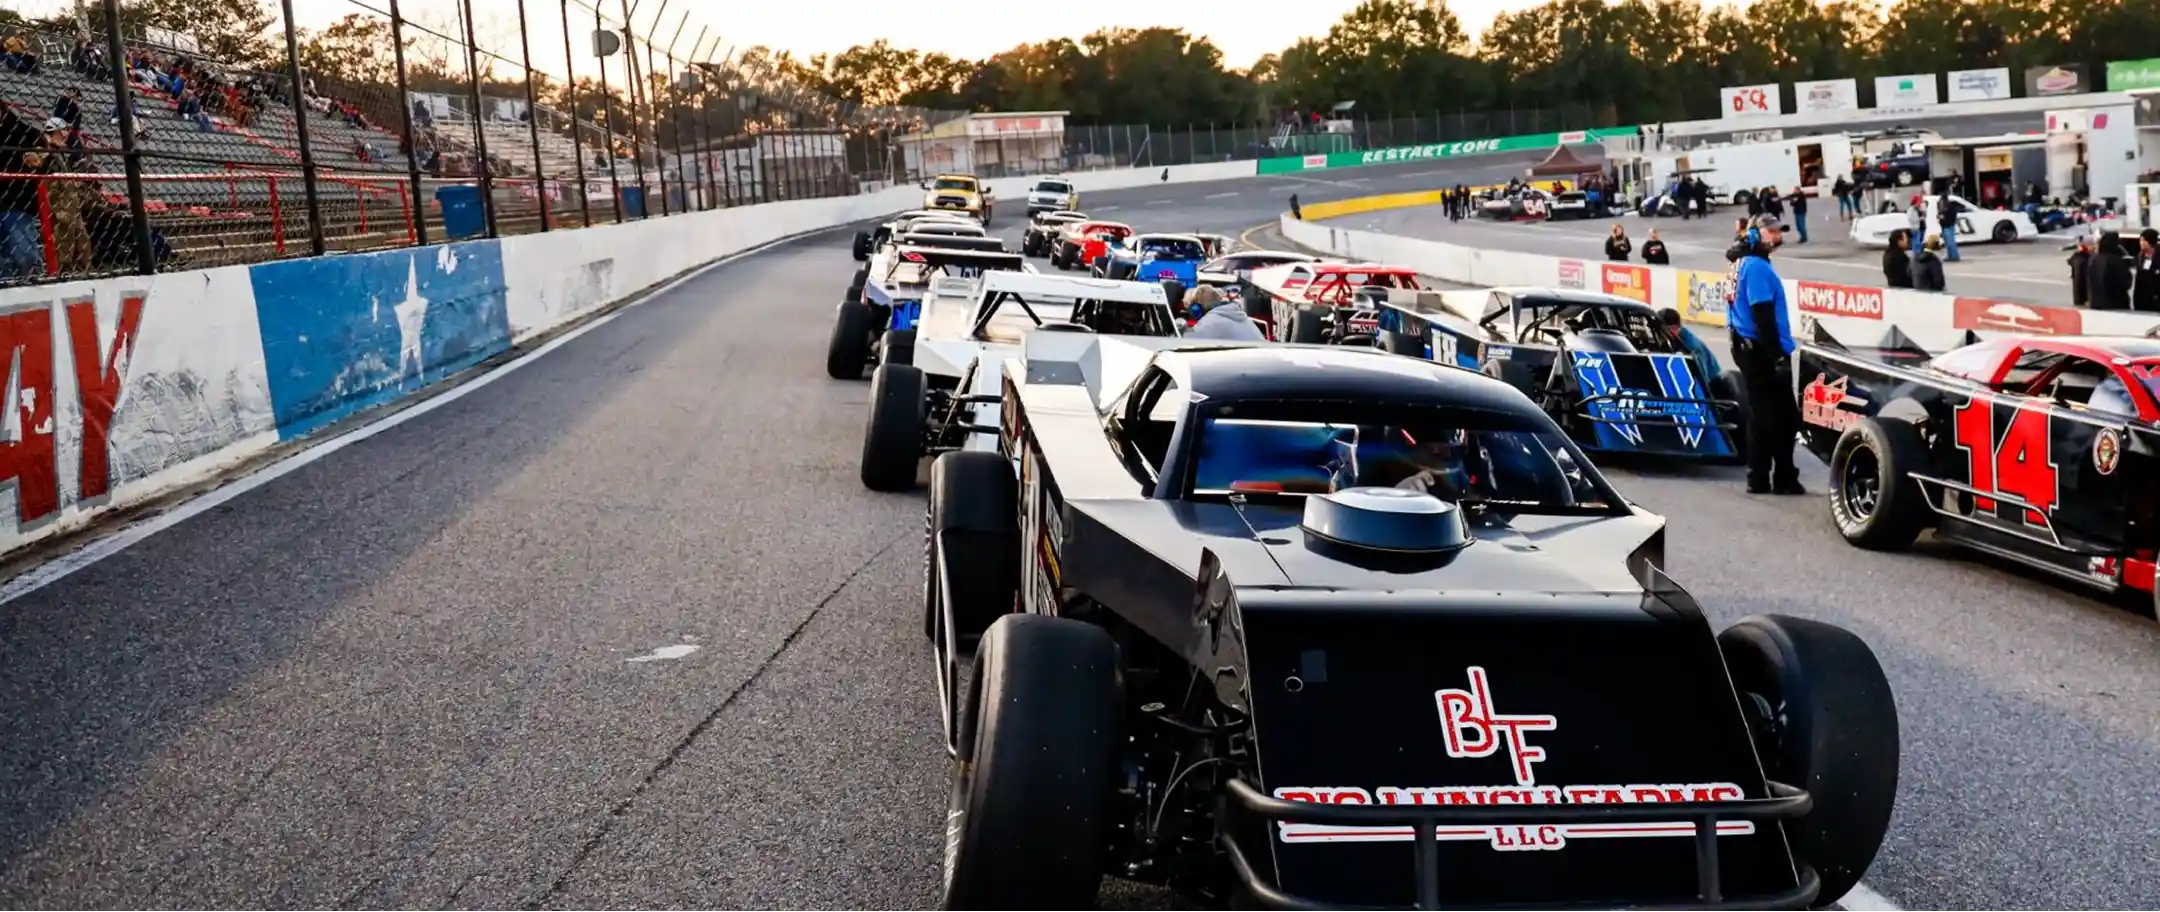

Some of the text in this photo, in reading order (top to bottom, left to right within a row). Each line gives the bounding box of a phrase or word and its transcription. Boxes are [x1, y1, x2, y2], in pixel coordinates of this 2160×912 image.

[1362, 138, 1501, 163] RESTART ZONE
[1799, 287, 1881, 314] NEWS RADIO
[1954, 391, 2059, 529] 14
[1494, 826, 1560, 846] LLC
